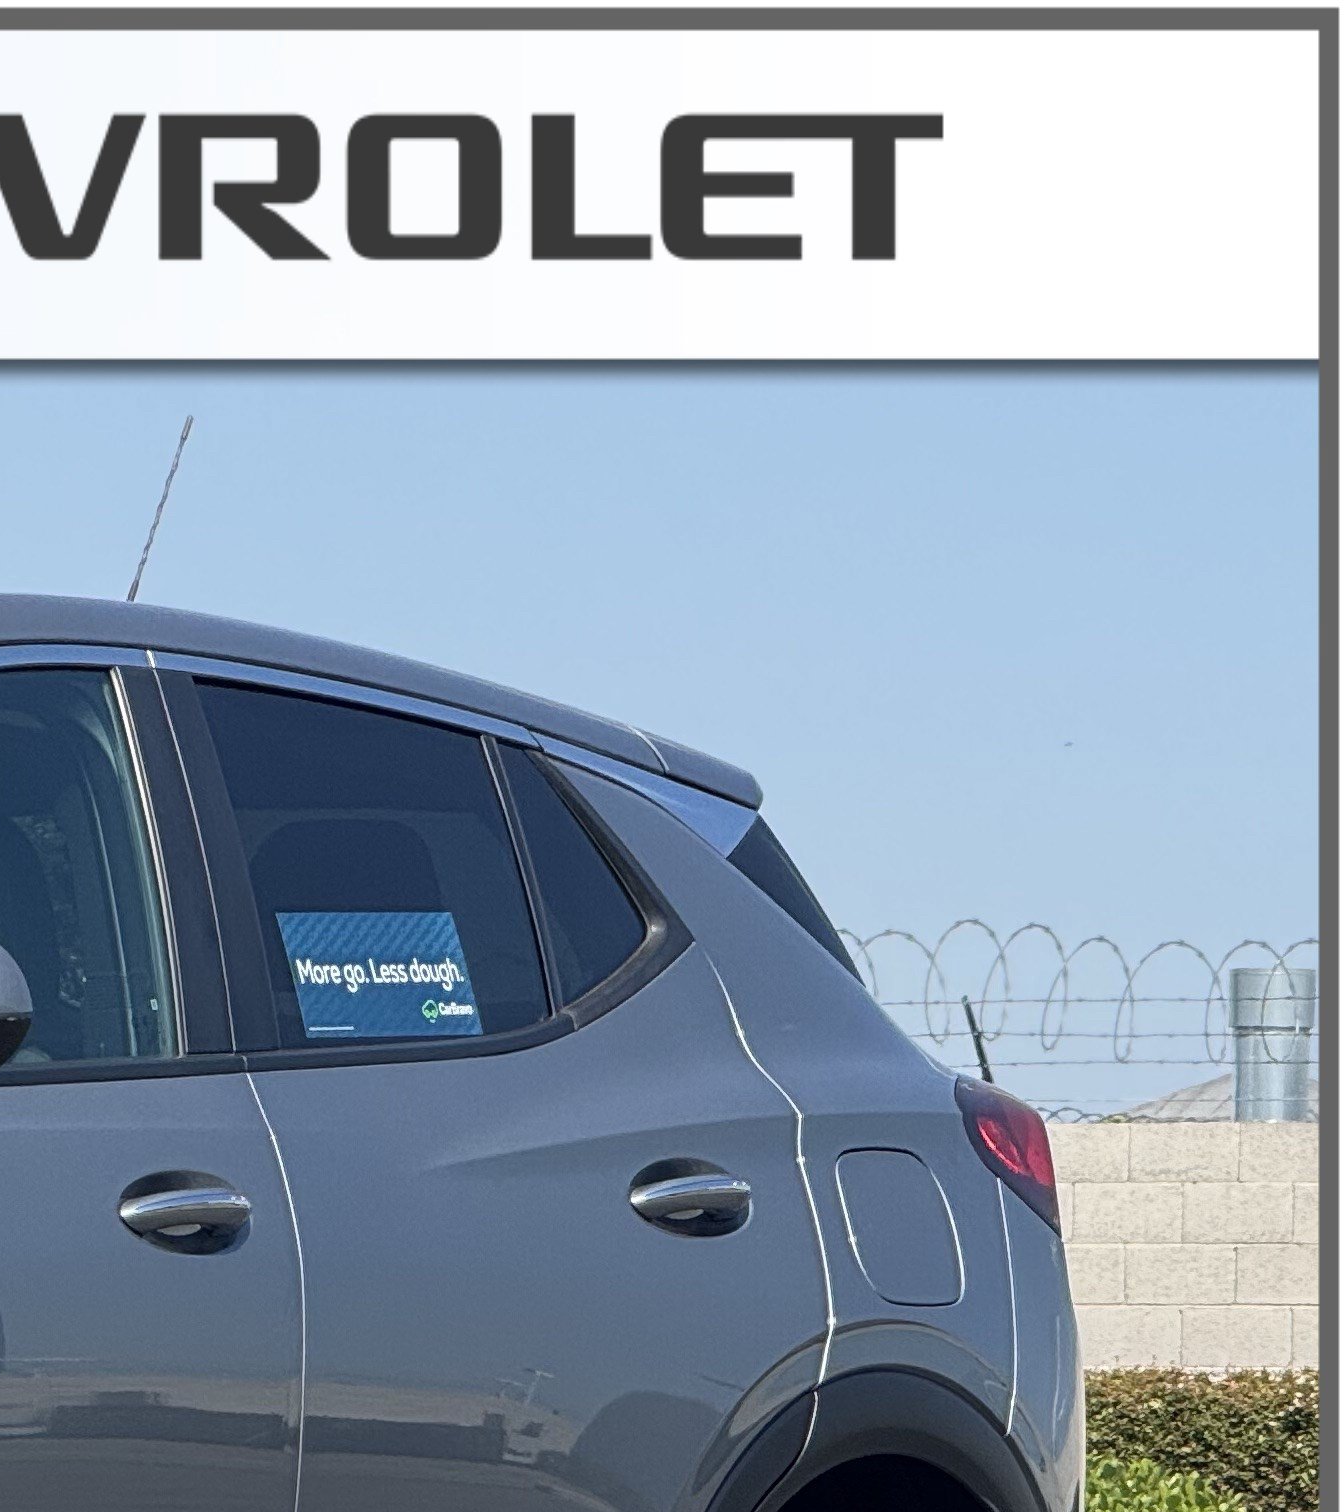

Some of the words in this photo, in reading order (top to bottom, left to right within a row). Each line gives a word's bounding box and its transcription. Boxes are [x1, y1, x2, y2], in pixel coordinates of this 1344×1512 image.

[295, 958, 342, 985] More
[343, 963, 370, 993] go.
[369, 958, 409, 985] Less
[409, 957, 465, 992] dough.
